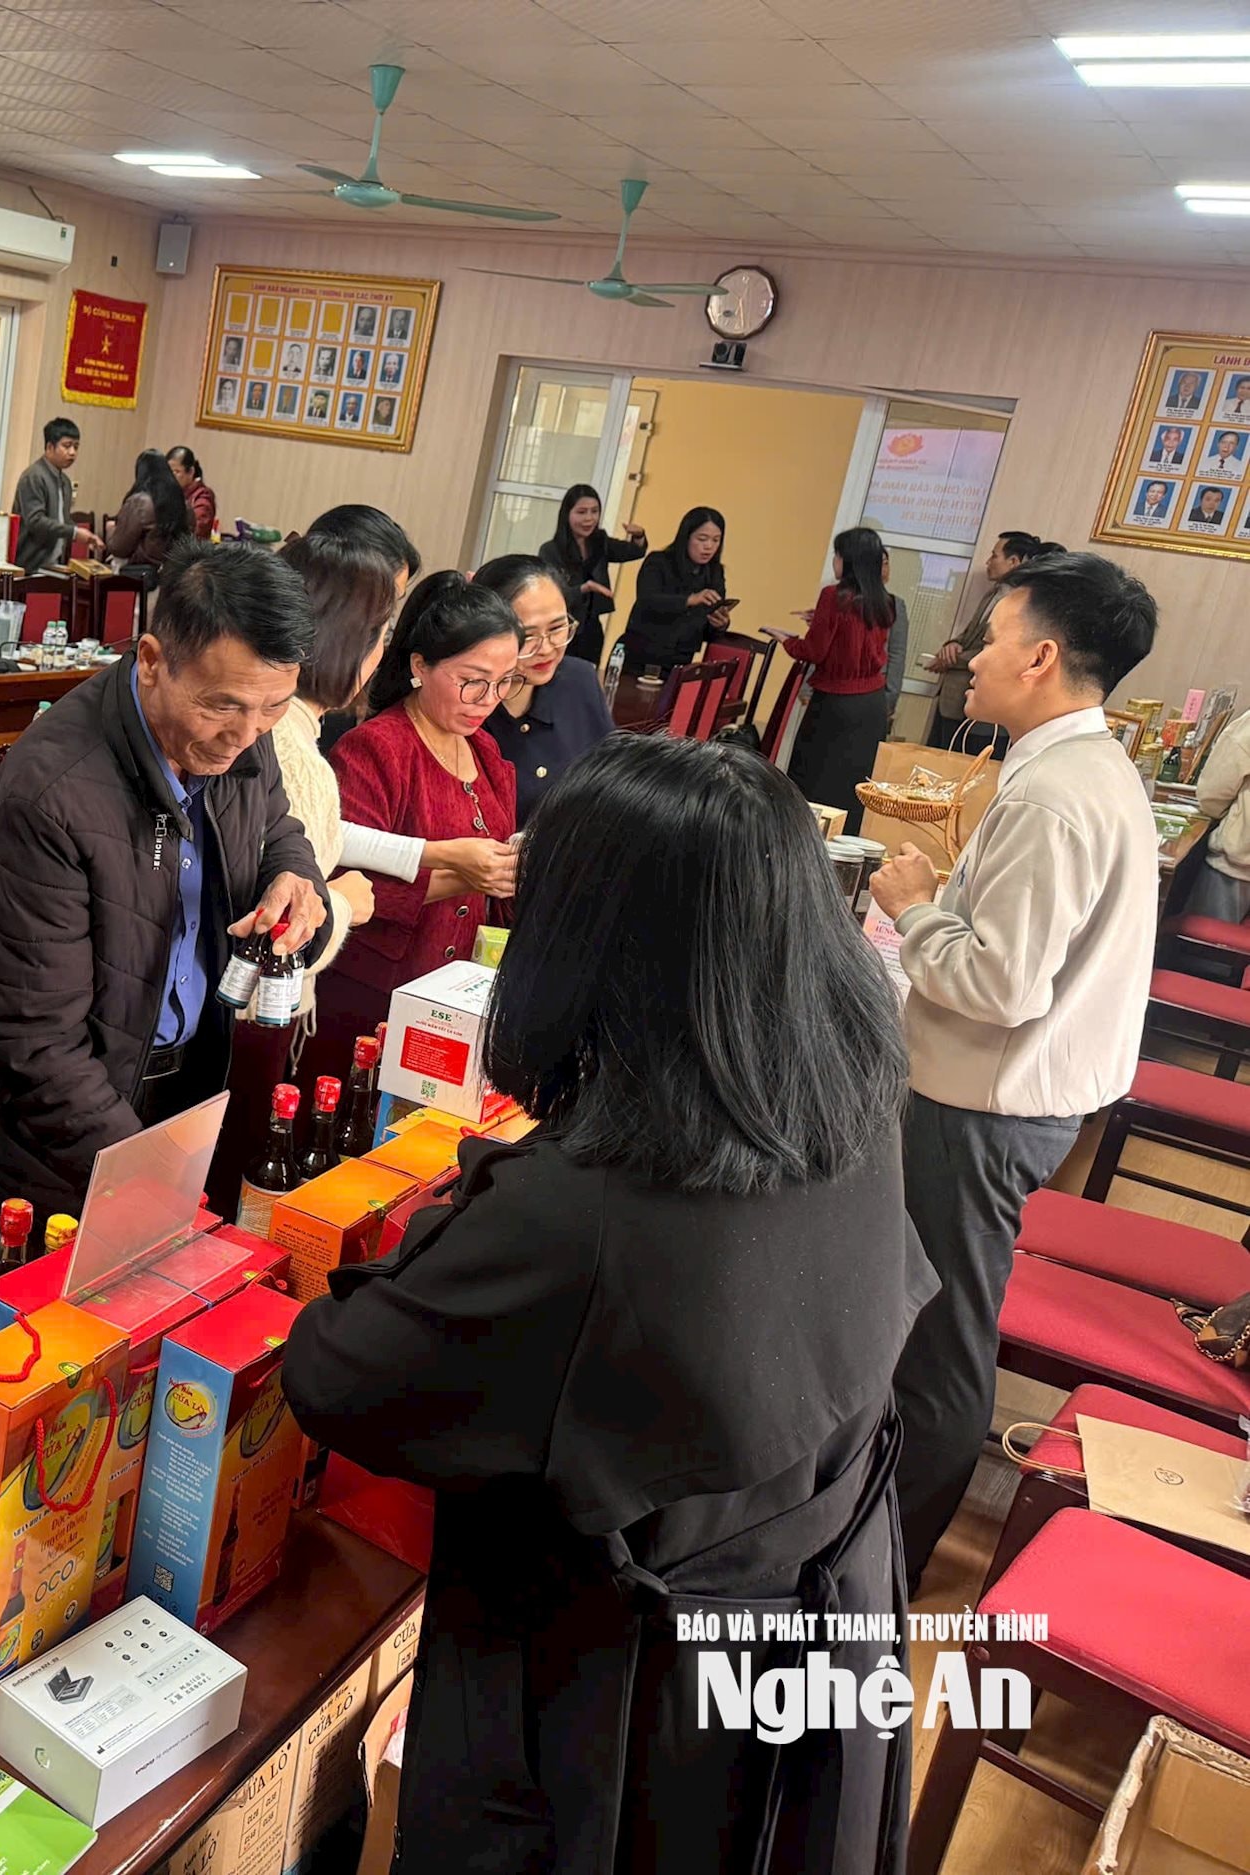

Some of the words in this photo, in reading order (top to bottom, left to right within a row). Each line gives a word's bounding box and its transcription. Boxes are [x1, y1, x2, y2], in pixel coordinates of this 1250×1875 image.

[431, 1009, 453, 1022] ESE
[172, 1388, 191, 1408] CỬA
[191, 1399, 207, 1416] LÒ
[393, 1621, 417, 1649] CỬA
[308, 1714, 333, 1745] CỬA
[336, 1690, 353, 1720] LÒ
[269, 1750, 288, 1781] LÒ
